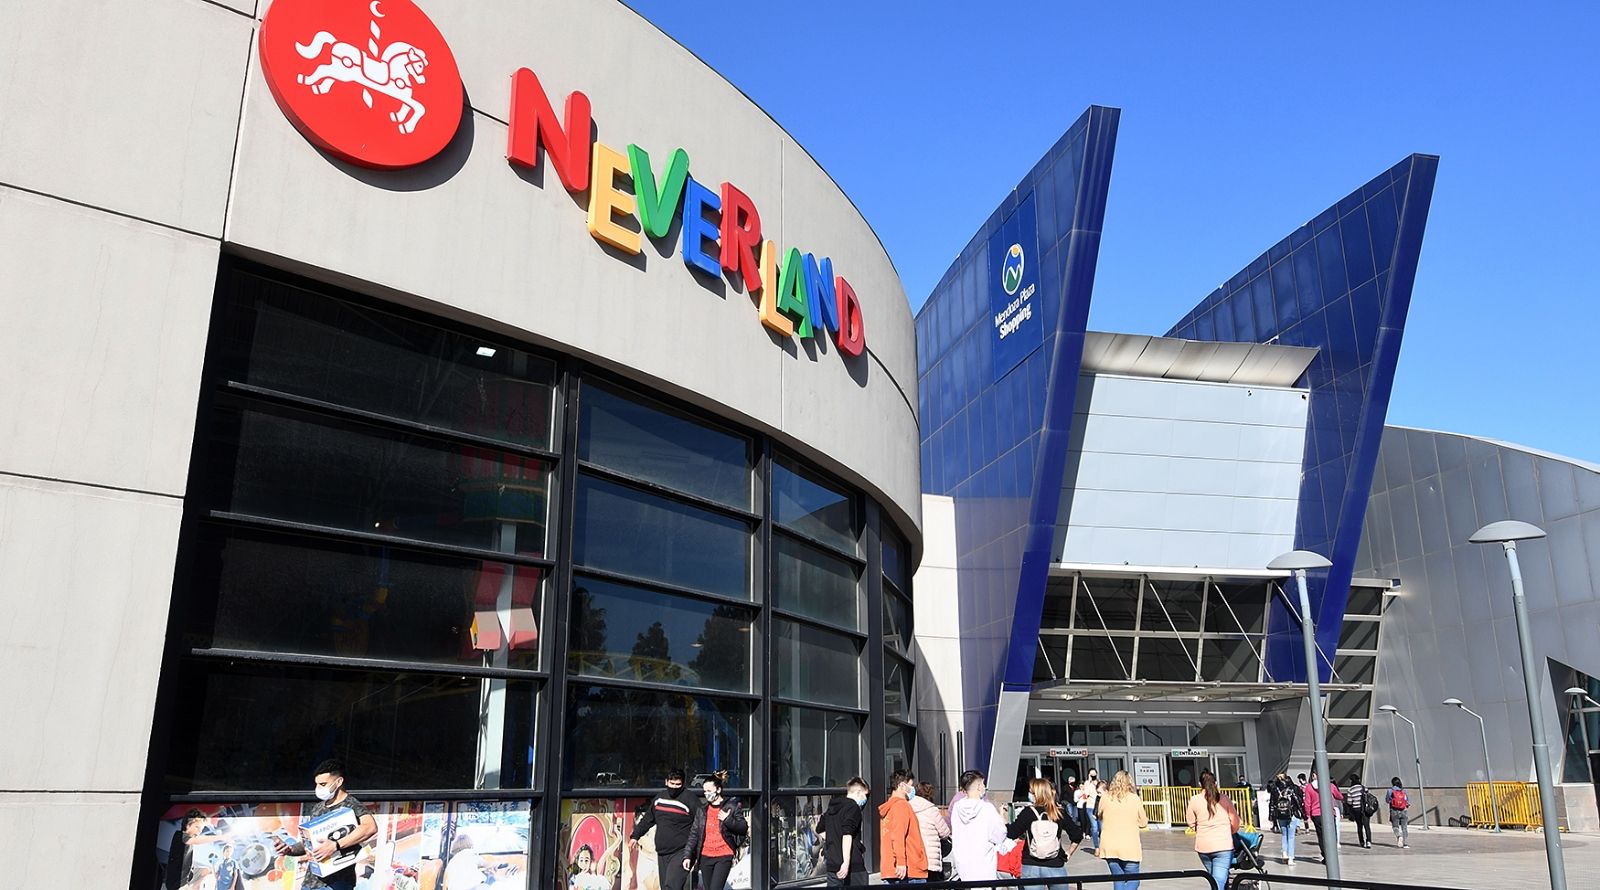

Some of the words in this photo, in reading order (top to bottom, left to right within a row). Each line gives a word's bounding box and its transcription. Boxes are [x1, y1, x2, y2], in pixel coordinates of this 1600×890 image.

[507, 67, 865, 357] NEVERLAND
[995, 298, 1020, 328] Mendoza
[1020, 283, 1035, 304] Plaza
[1000, 303, 1032, 339] Shopping
